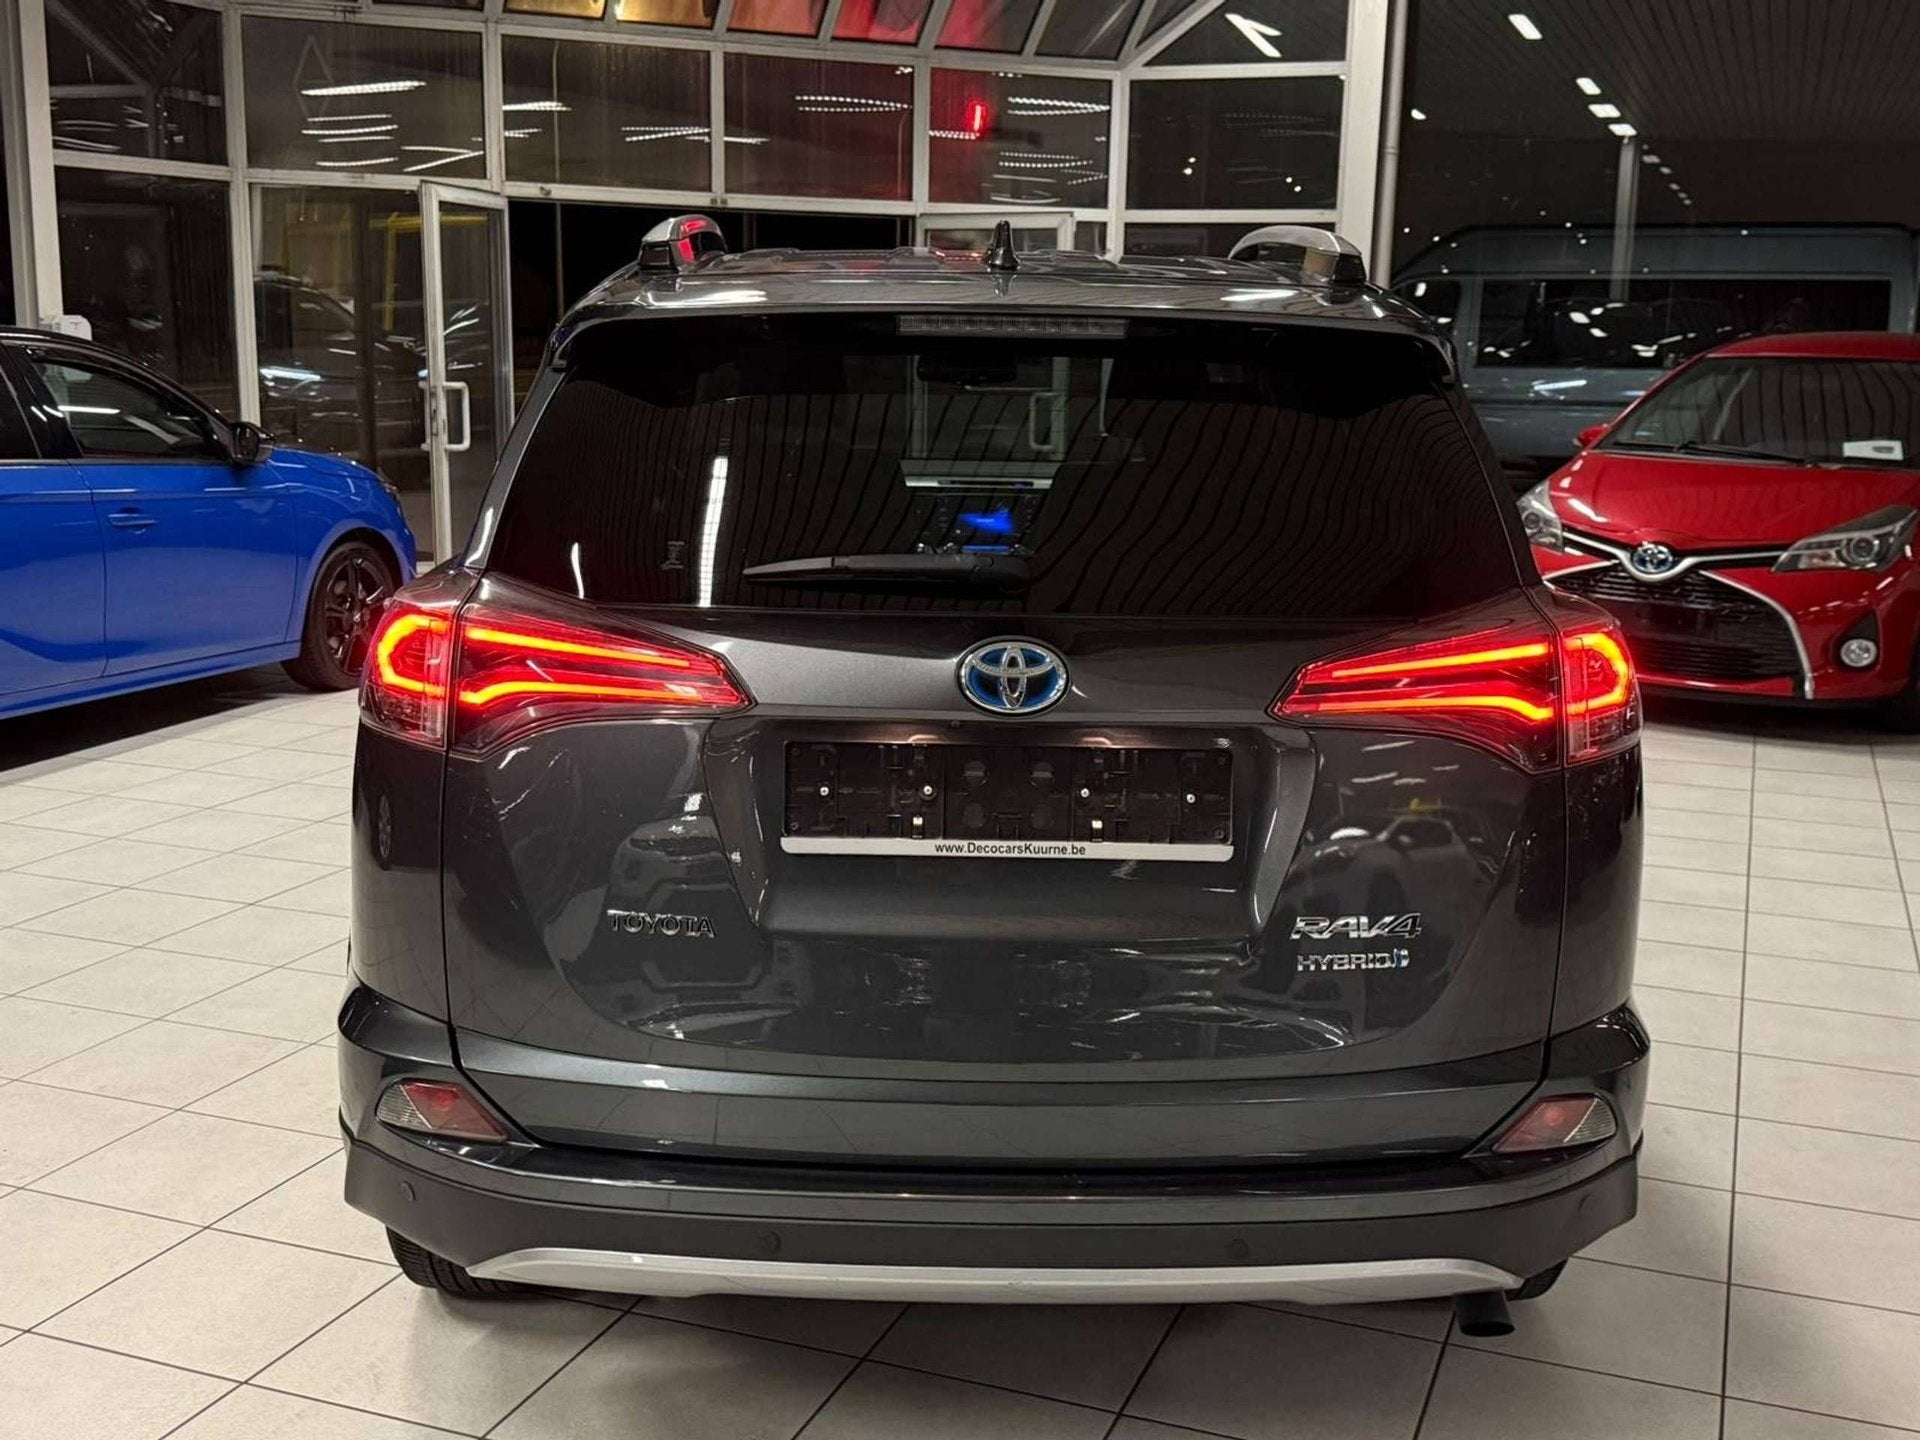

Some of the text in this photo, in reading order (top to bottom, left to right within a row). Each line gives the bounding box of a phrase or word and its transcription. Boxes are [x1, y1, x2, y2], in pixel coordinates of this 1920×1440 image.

[935, 842, 1086, 855] www.DecocarsKuurne.be
[607, 909, 714, 938] TOYOTA
[1290, 913, 1422, 939] RAV4
[1297, 952, 1395, 971] HYBRID
